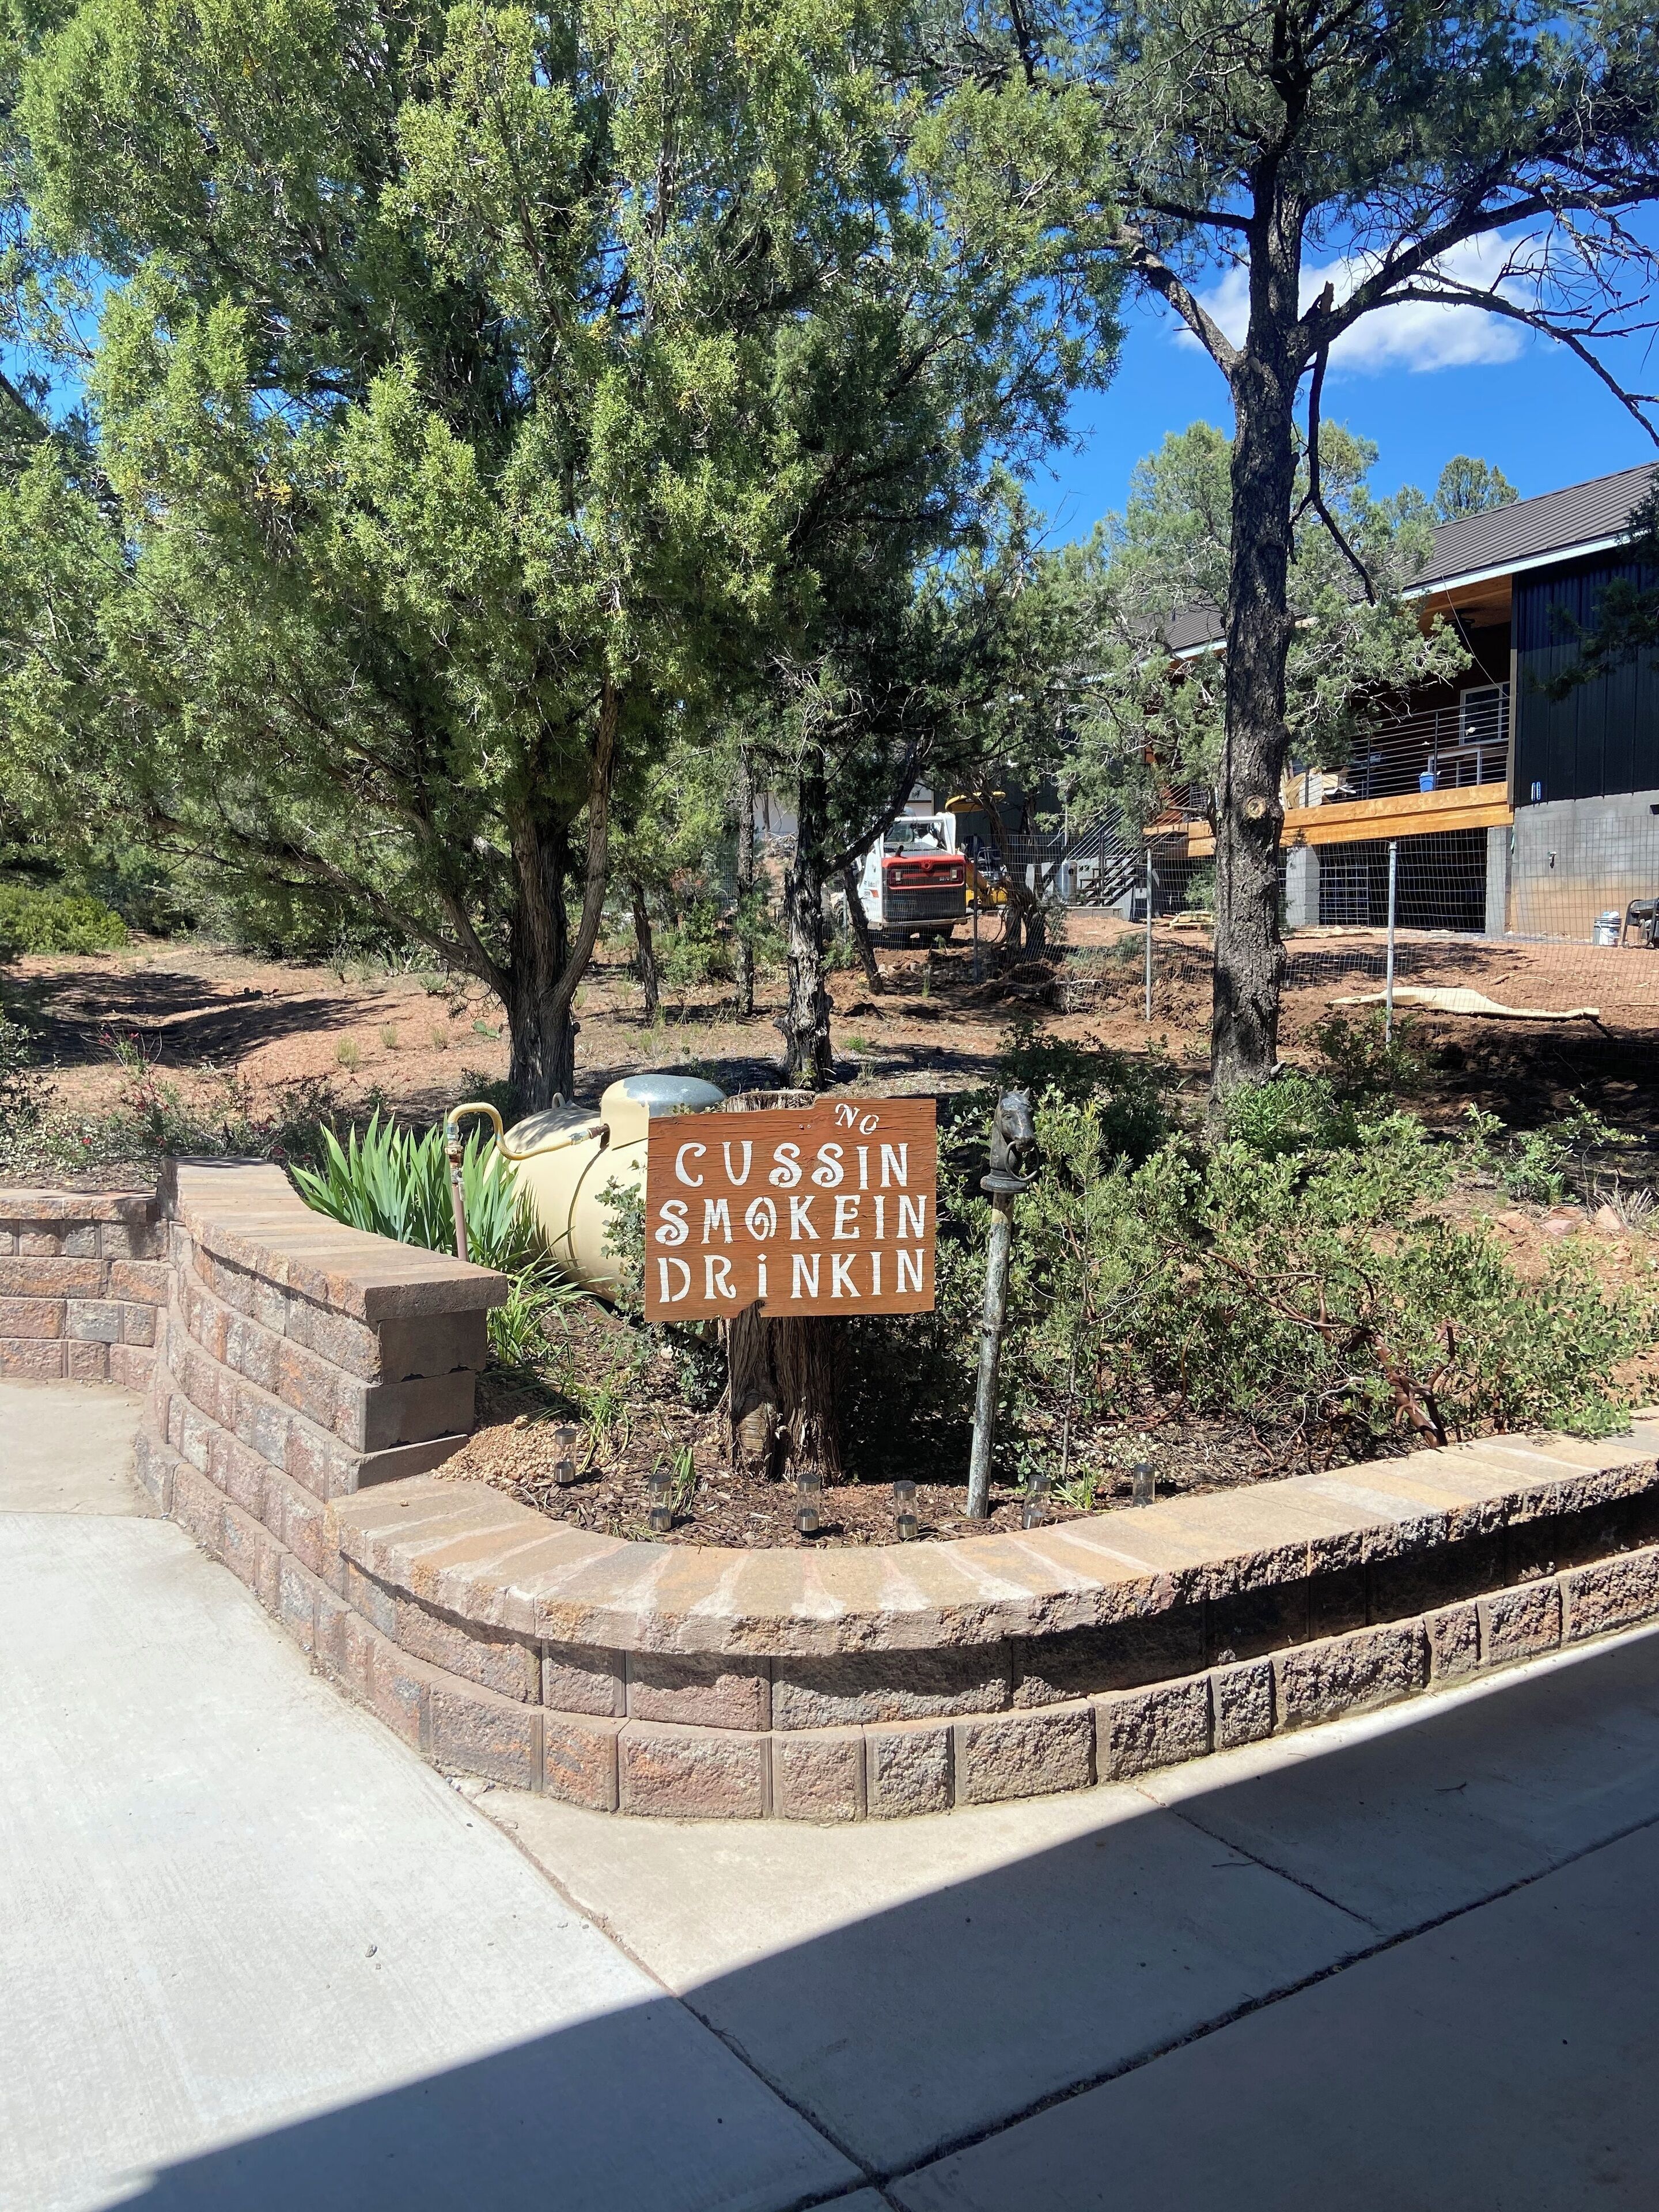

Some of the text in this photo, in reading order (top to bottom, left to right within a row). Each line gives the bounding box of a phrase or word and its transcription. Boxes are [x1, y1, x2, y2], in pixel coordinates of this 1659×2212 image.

[835, 1103, 880, 1135] NO
[675, 1140, 909, 1190] CUSSIN
[654, 1194, 928, 1247] SMOKEIN
